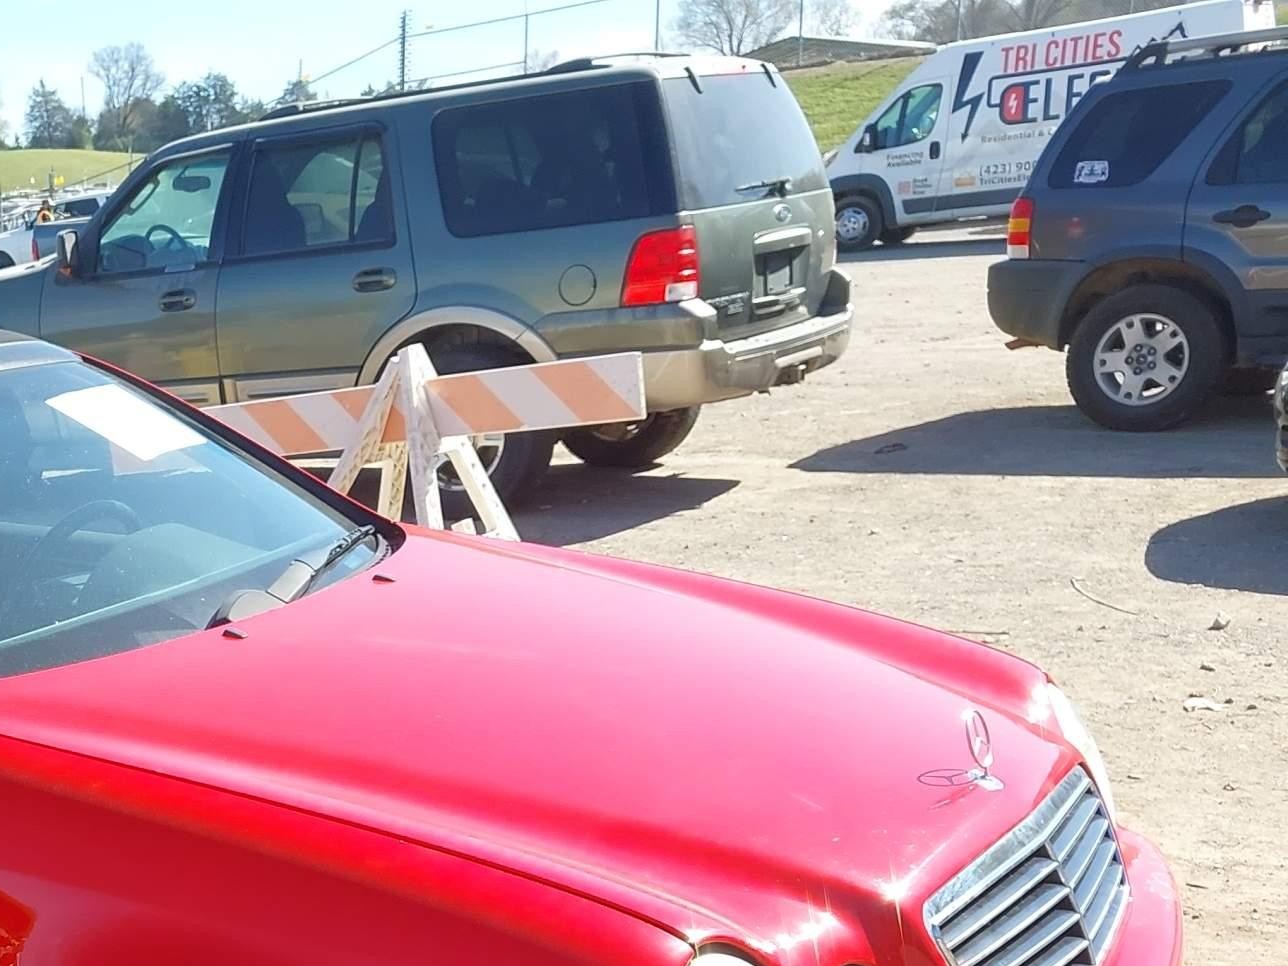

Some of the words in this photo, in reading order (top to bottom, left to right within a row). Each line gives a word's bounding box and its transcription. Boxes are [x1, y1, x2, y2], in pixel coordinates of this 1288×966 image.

[1001, 44, 1037, 73] TRI
[1044, 30, 1123, 67] CITIES
[981, 130, 1035, 143] Residential
[887, 160, 921, 168] Available
[979, 162, 1012, 177] (423)
